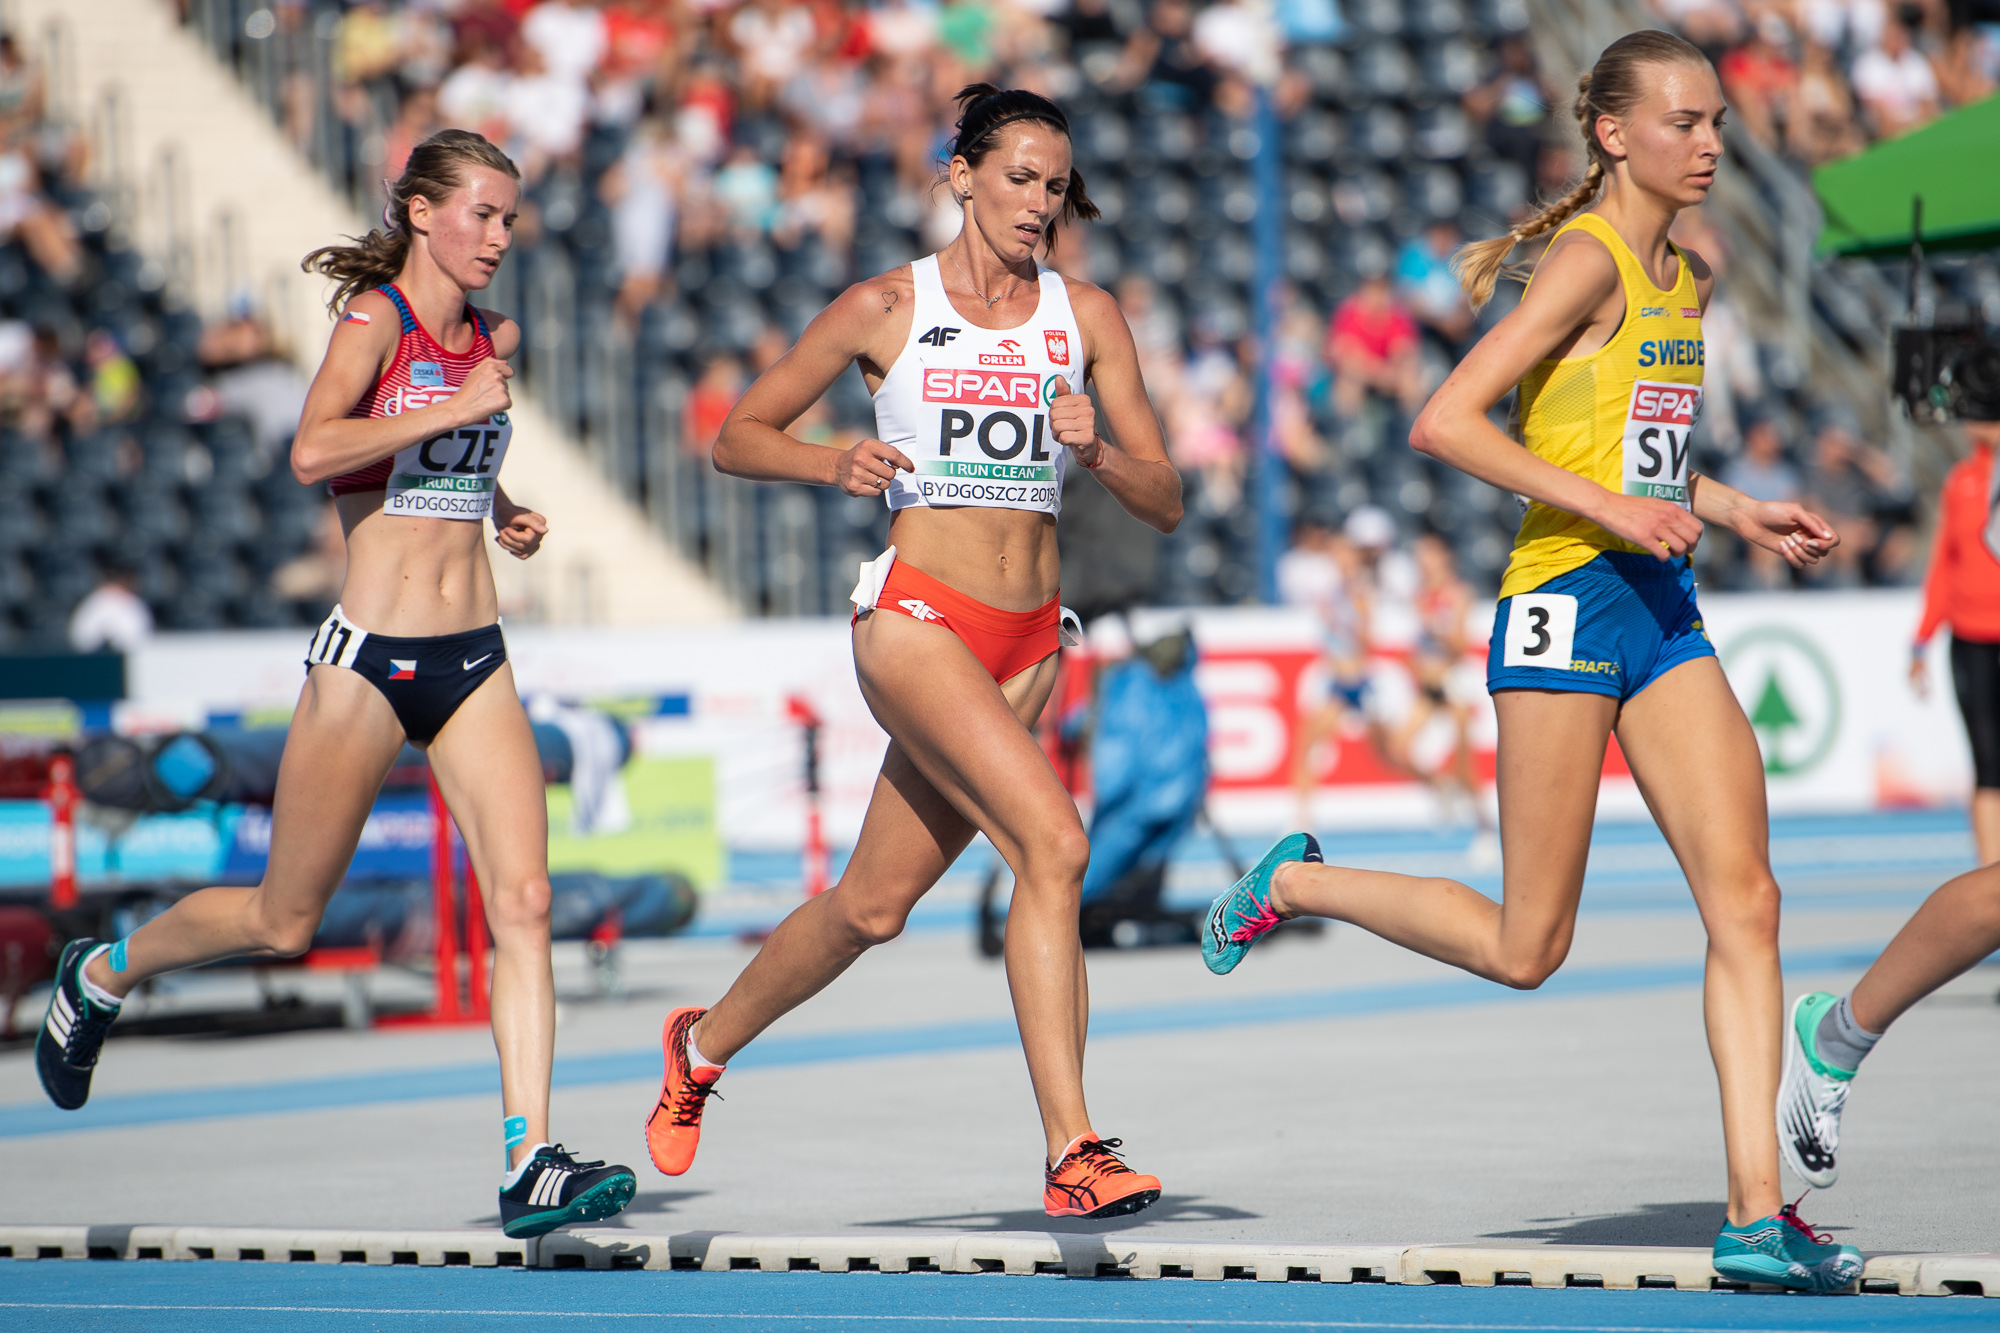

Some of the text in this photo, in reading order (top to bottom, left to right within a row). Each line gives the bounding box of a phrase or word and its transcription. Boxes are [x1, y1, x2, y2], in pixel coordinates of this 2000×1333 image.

[918, 326, 962, 347] 4F
[980, 355, 1023, 365] ORLEN
[926, 373, 1037, 403] SPAR
[939, 408, 1050, 461] POL
[418, 430, 499, 474] CZE
[950, 462, 954, 474] I
[957, 463, 989, 476] RUN
[425, 477, 454, 490] RUN
[923, 482, 1056, 502] BYDGOSZCZ 2019
[1647, 484, 1652, 497] I
[1654, 485, 1675, 499] RUN
[897, 599, 945, 621] 4F
[1523, 606, 1551, 656] 3
